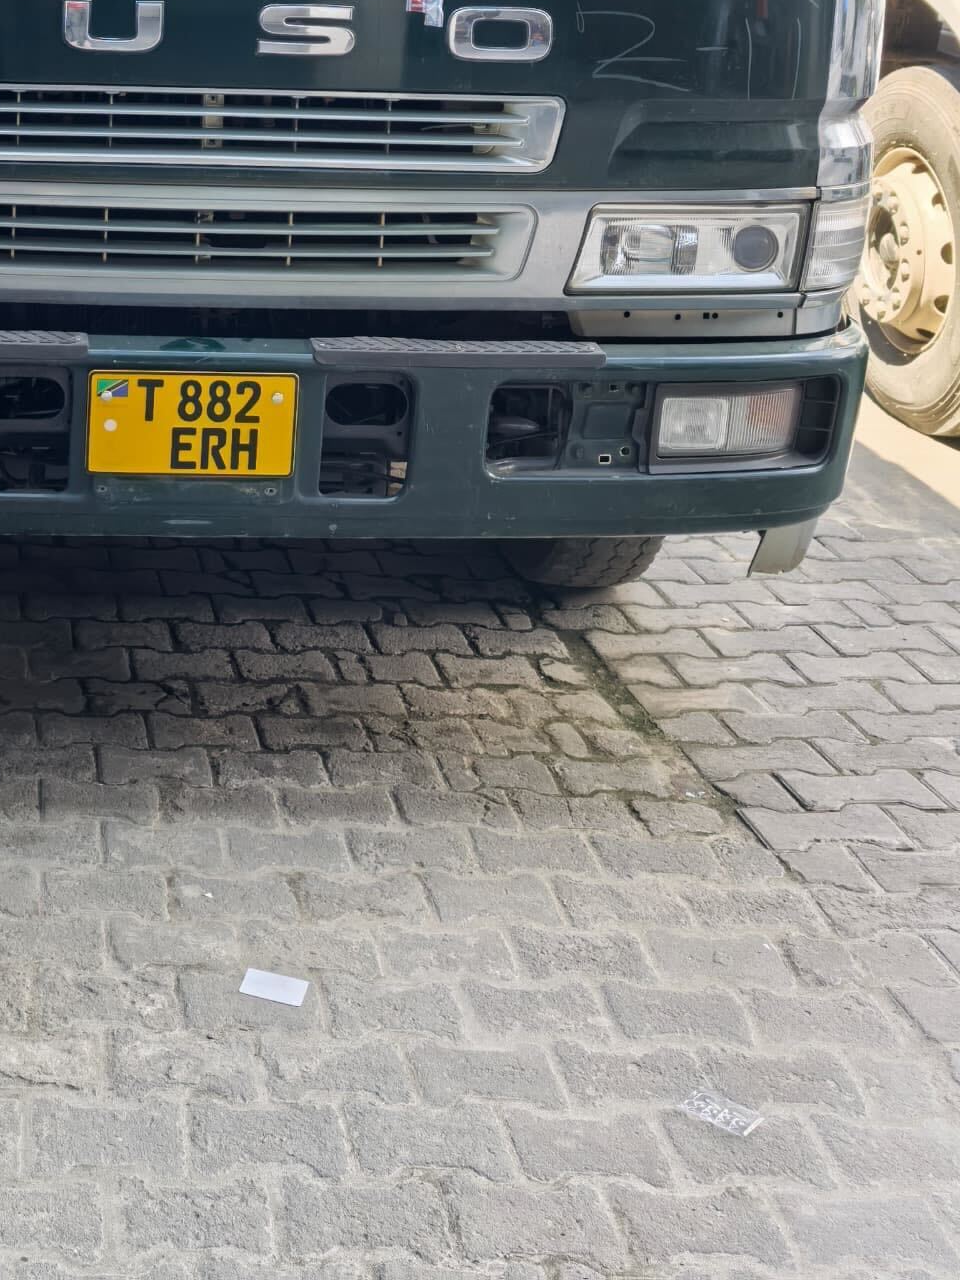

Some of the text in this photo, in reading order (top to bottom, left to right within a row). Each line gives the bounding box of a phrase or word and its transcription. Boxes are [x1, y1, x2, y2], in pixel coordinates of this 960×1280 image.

[137, 378, 262, 424] T 882
[170, 426, 259, 470] ERH
